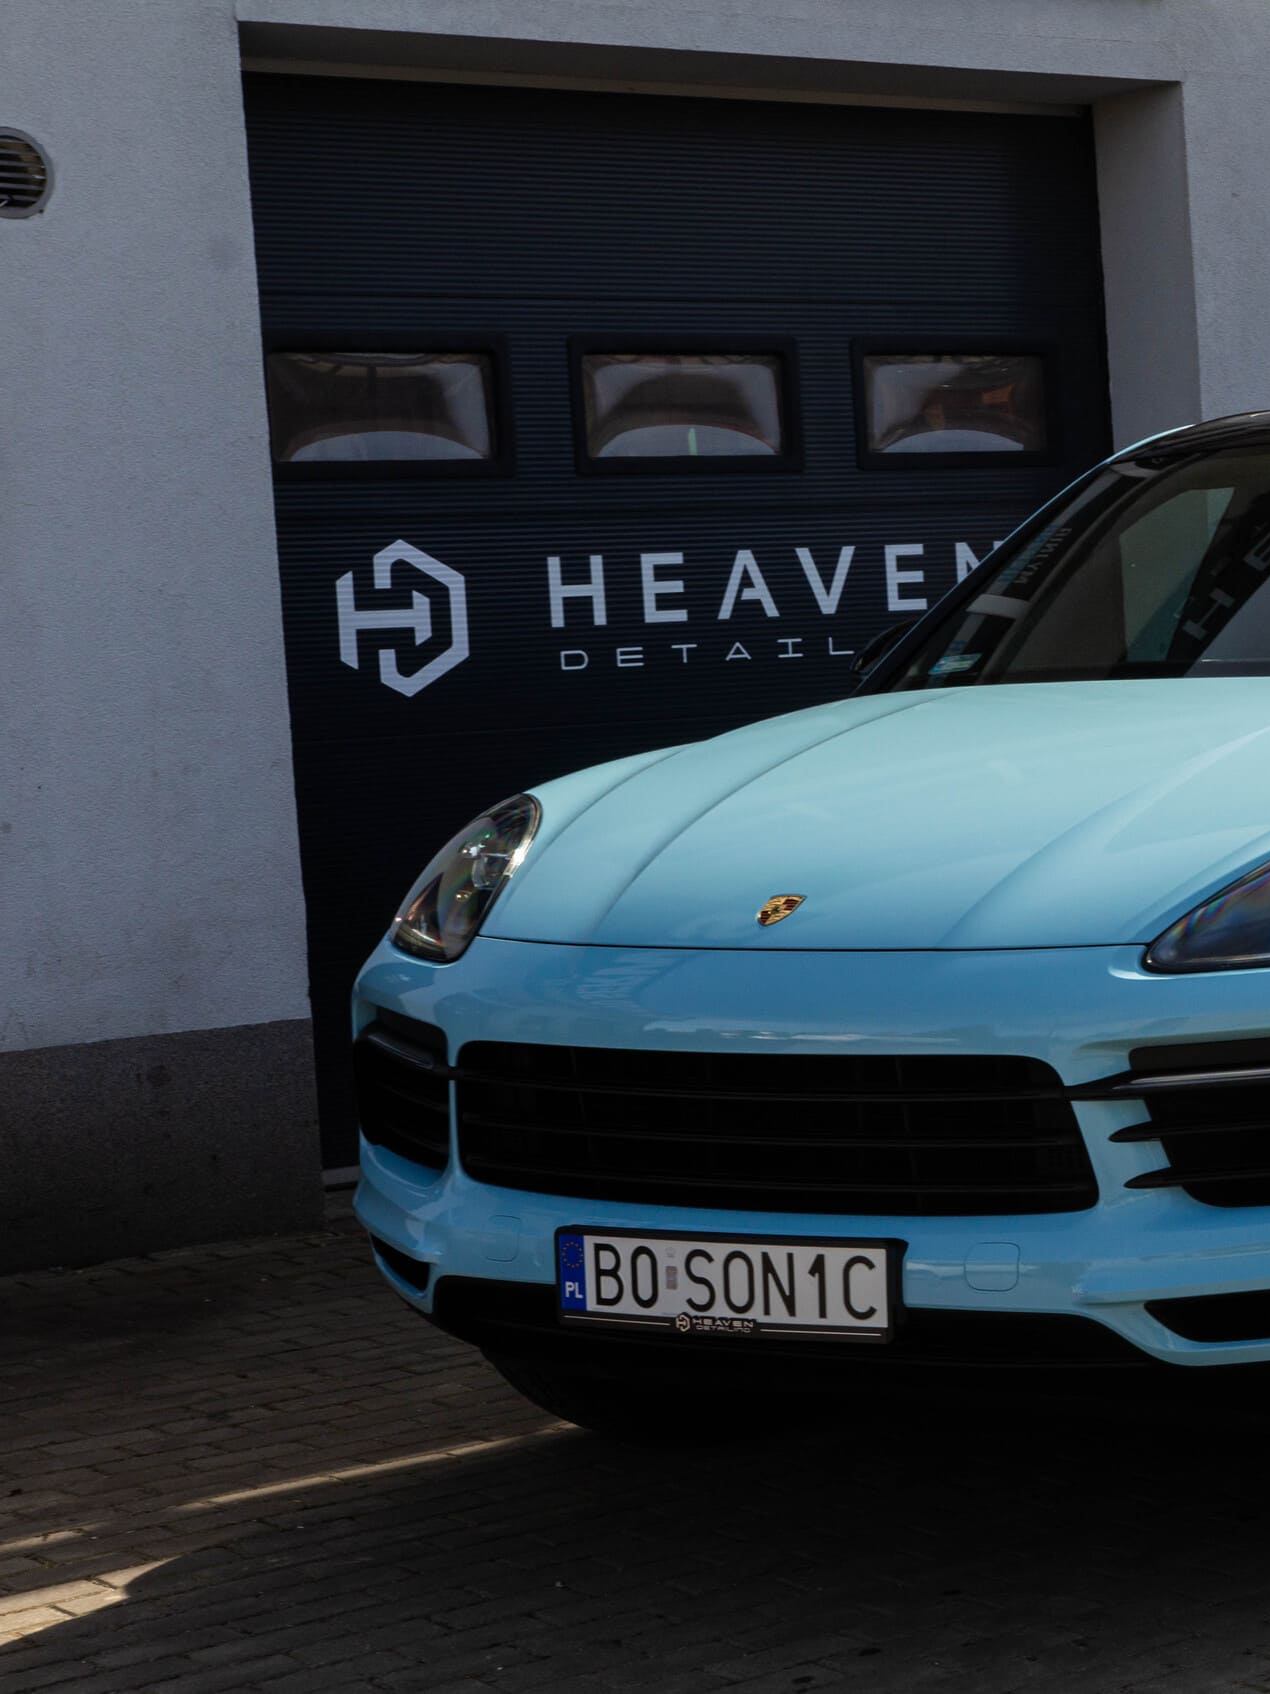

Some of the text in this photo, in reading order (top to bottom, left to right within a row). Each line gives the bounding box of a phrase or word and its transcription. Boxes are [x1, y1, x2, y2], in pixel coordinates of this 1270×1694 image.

[565, 1281, 583, 1299] PL
[684, 1248, 877, 1321] SON1C
[692, 1317, 754, 1329] HEAVEN
